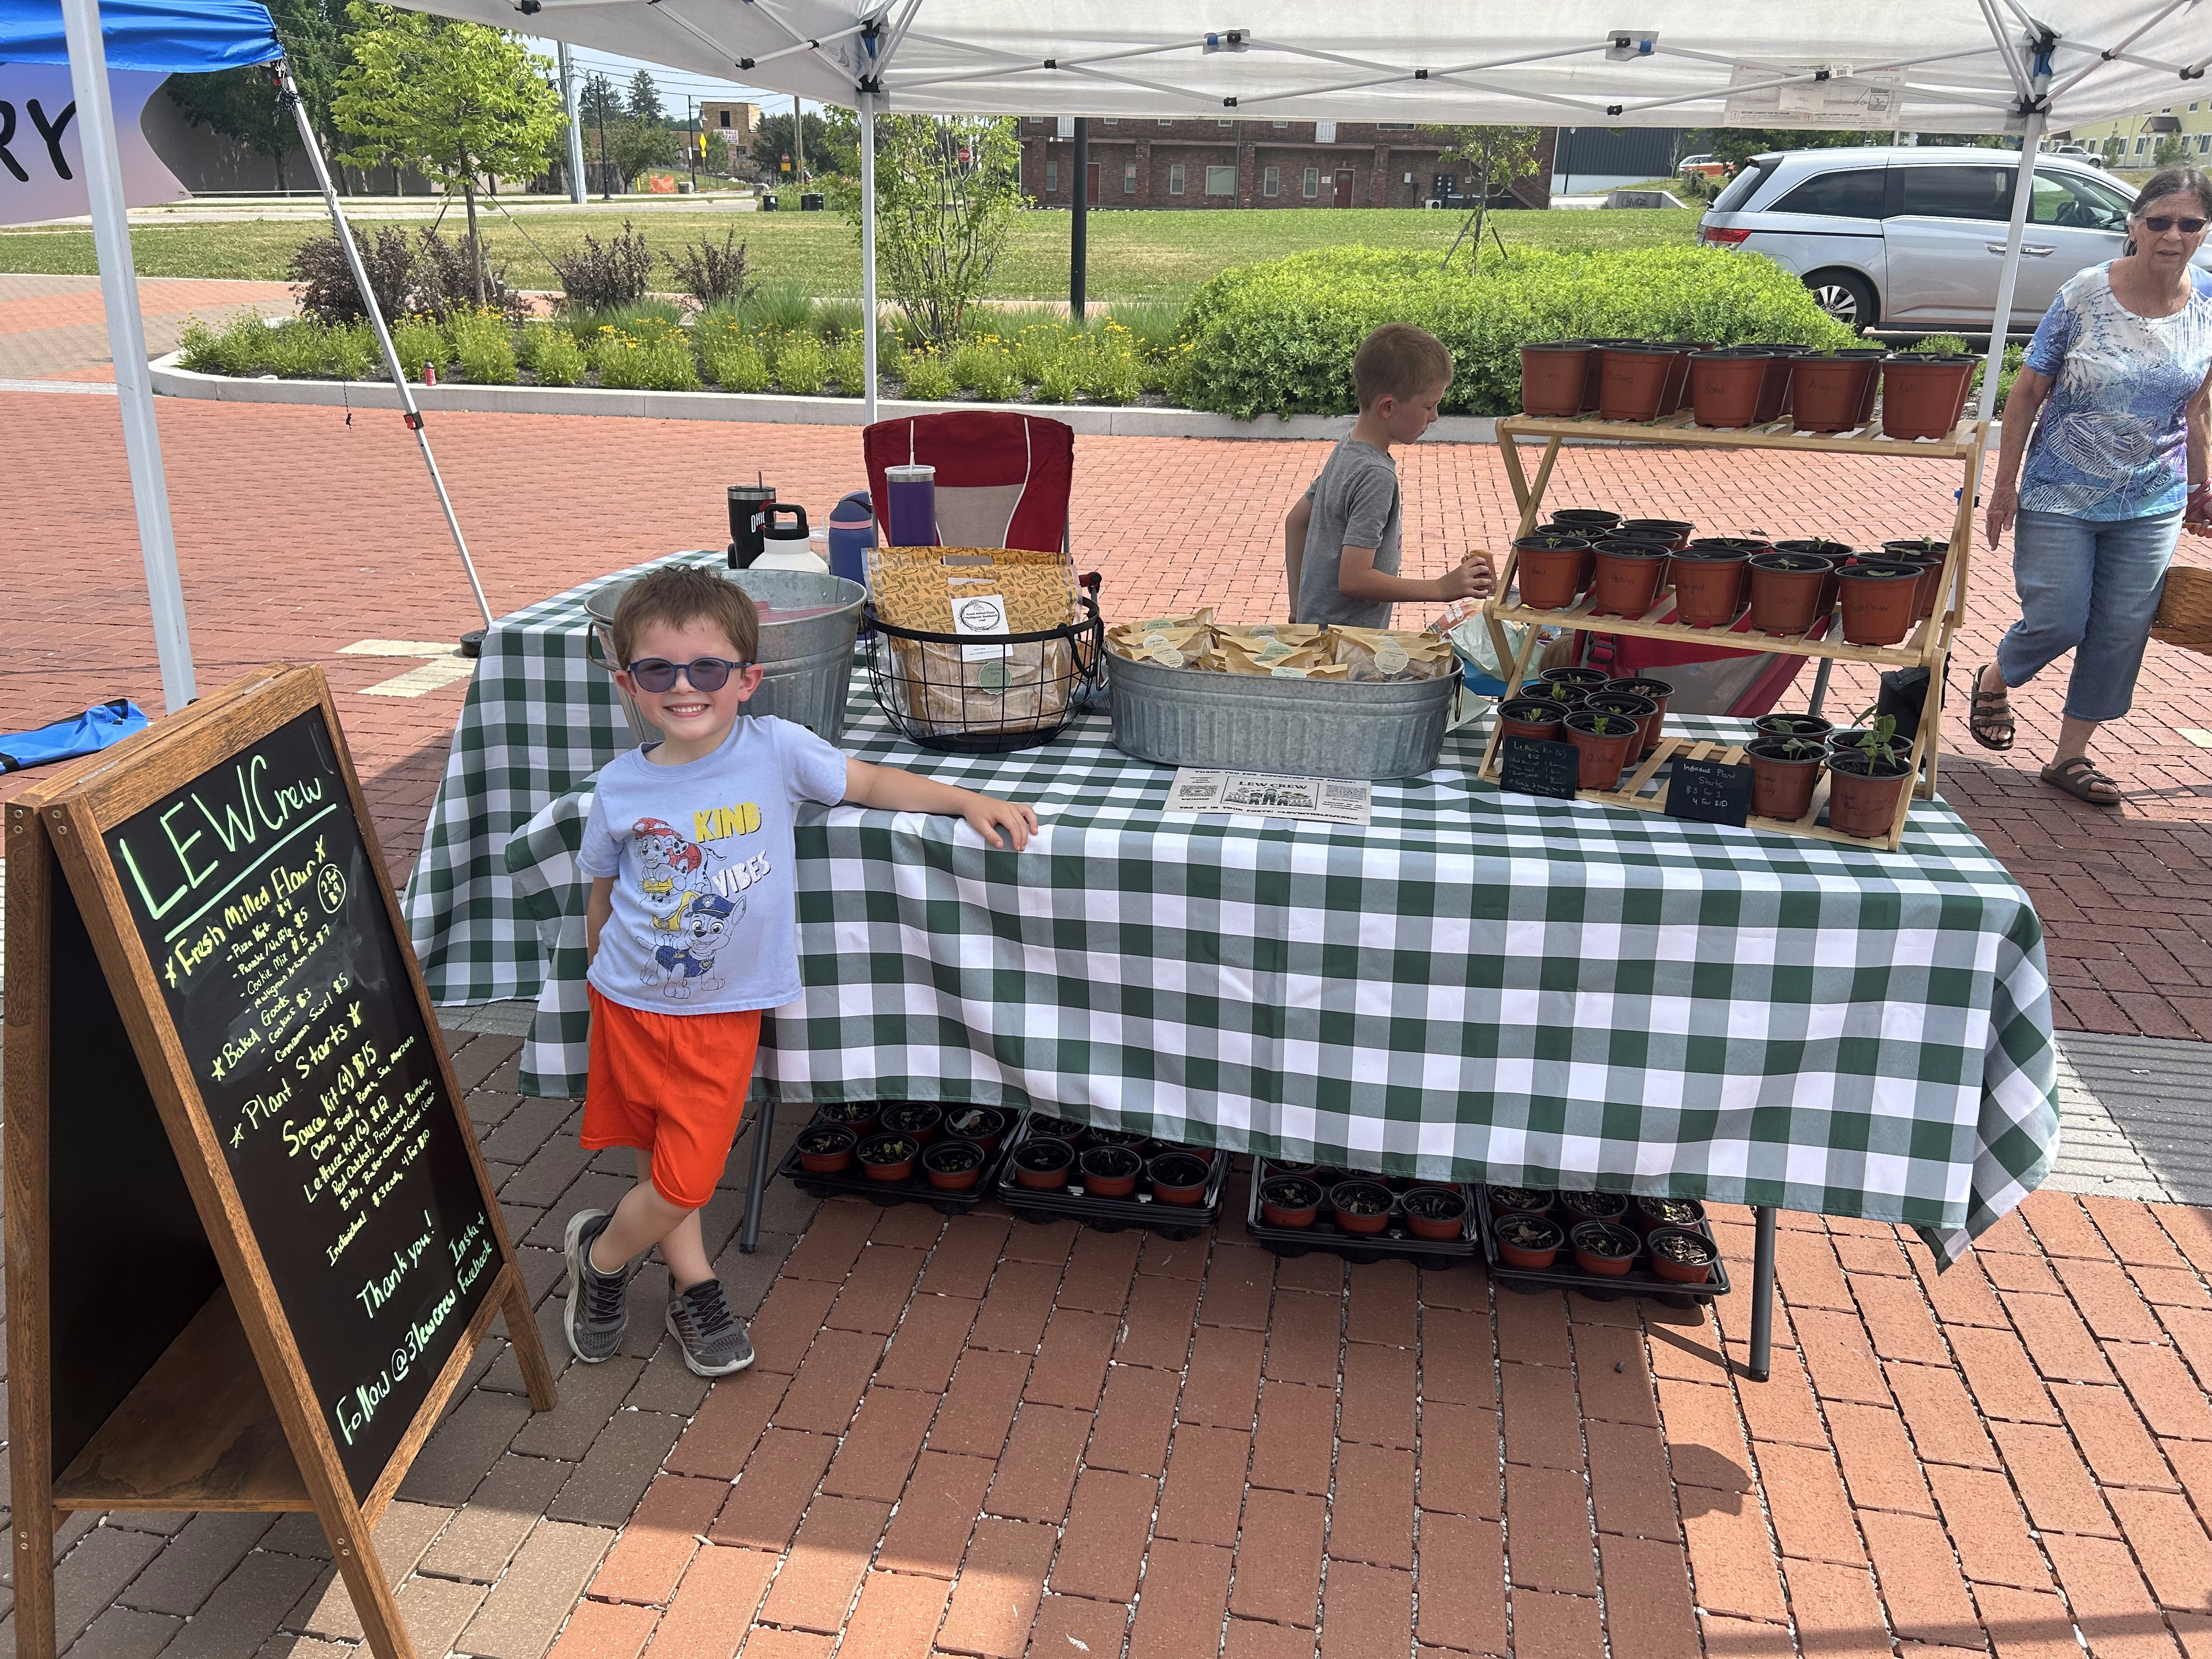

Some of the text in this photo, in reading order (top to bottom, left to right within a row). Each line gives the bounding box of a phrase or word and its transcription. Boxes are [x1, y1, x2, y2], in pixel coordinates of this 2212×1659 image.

[1698, 776, 1724, 788] Starts
[1717, 768, 1736, 779] Plant
[693, 802, 762, 844] KIND
[712, 849, 771, 898] VIBES
[174, 860, 316, 977] Fresh Milled Flour
[231, 939, 253, 958] Pizza
[276, 898, 292, 918] $4
[294, 906, 308, 929] $5
[316, 923, 330, 946] $7
[247, 968, 273, 995] Cookie
[273, 952, 289, 970] Mix
[309, 991, 334, 1022] Swirl
[332, 972, 349, 995] $5
[222, 995, 291, 1069] Baked Goods
[268, 987, 312, 1044] Cookies $3
[241, 1023, 348, 1130] Plant Starts
[283, 1116, 326, 1157] Sauce
[351, 1040, 377, 1079] $15
[376, 1065, 392, 1079] San
[303, 1153, 347, 1204] Lettuce
[369, 1094, 390, 1123] $12
[331, 1173, 348, 1197] Red
[326, 1210, 368, 1267] Individual
[356, 1209, 436, 1319] Thank you!
[448, 1222, 479, 1267] Insta
[456, 1238, 494, 1295] Facebook
[335, 1370, 392, 1447] Follow
